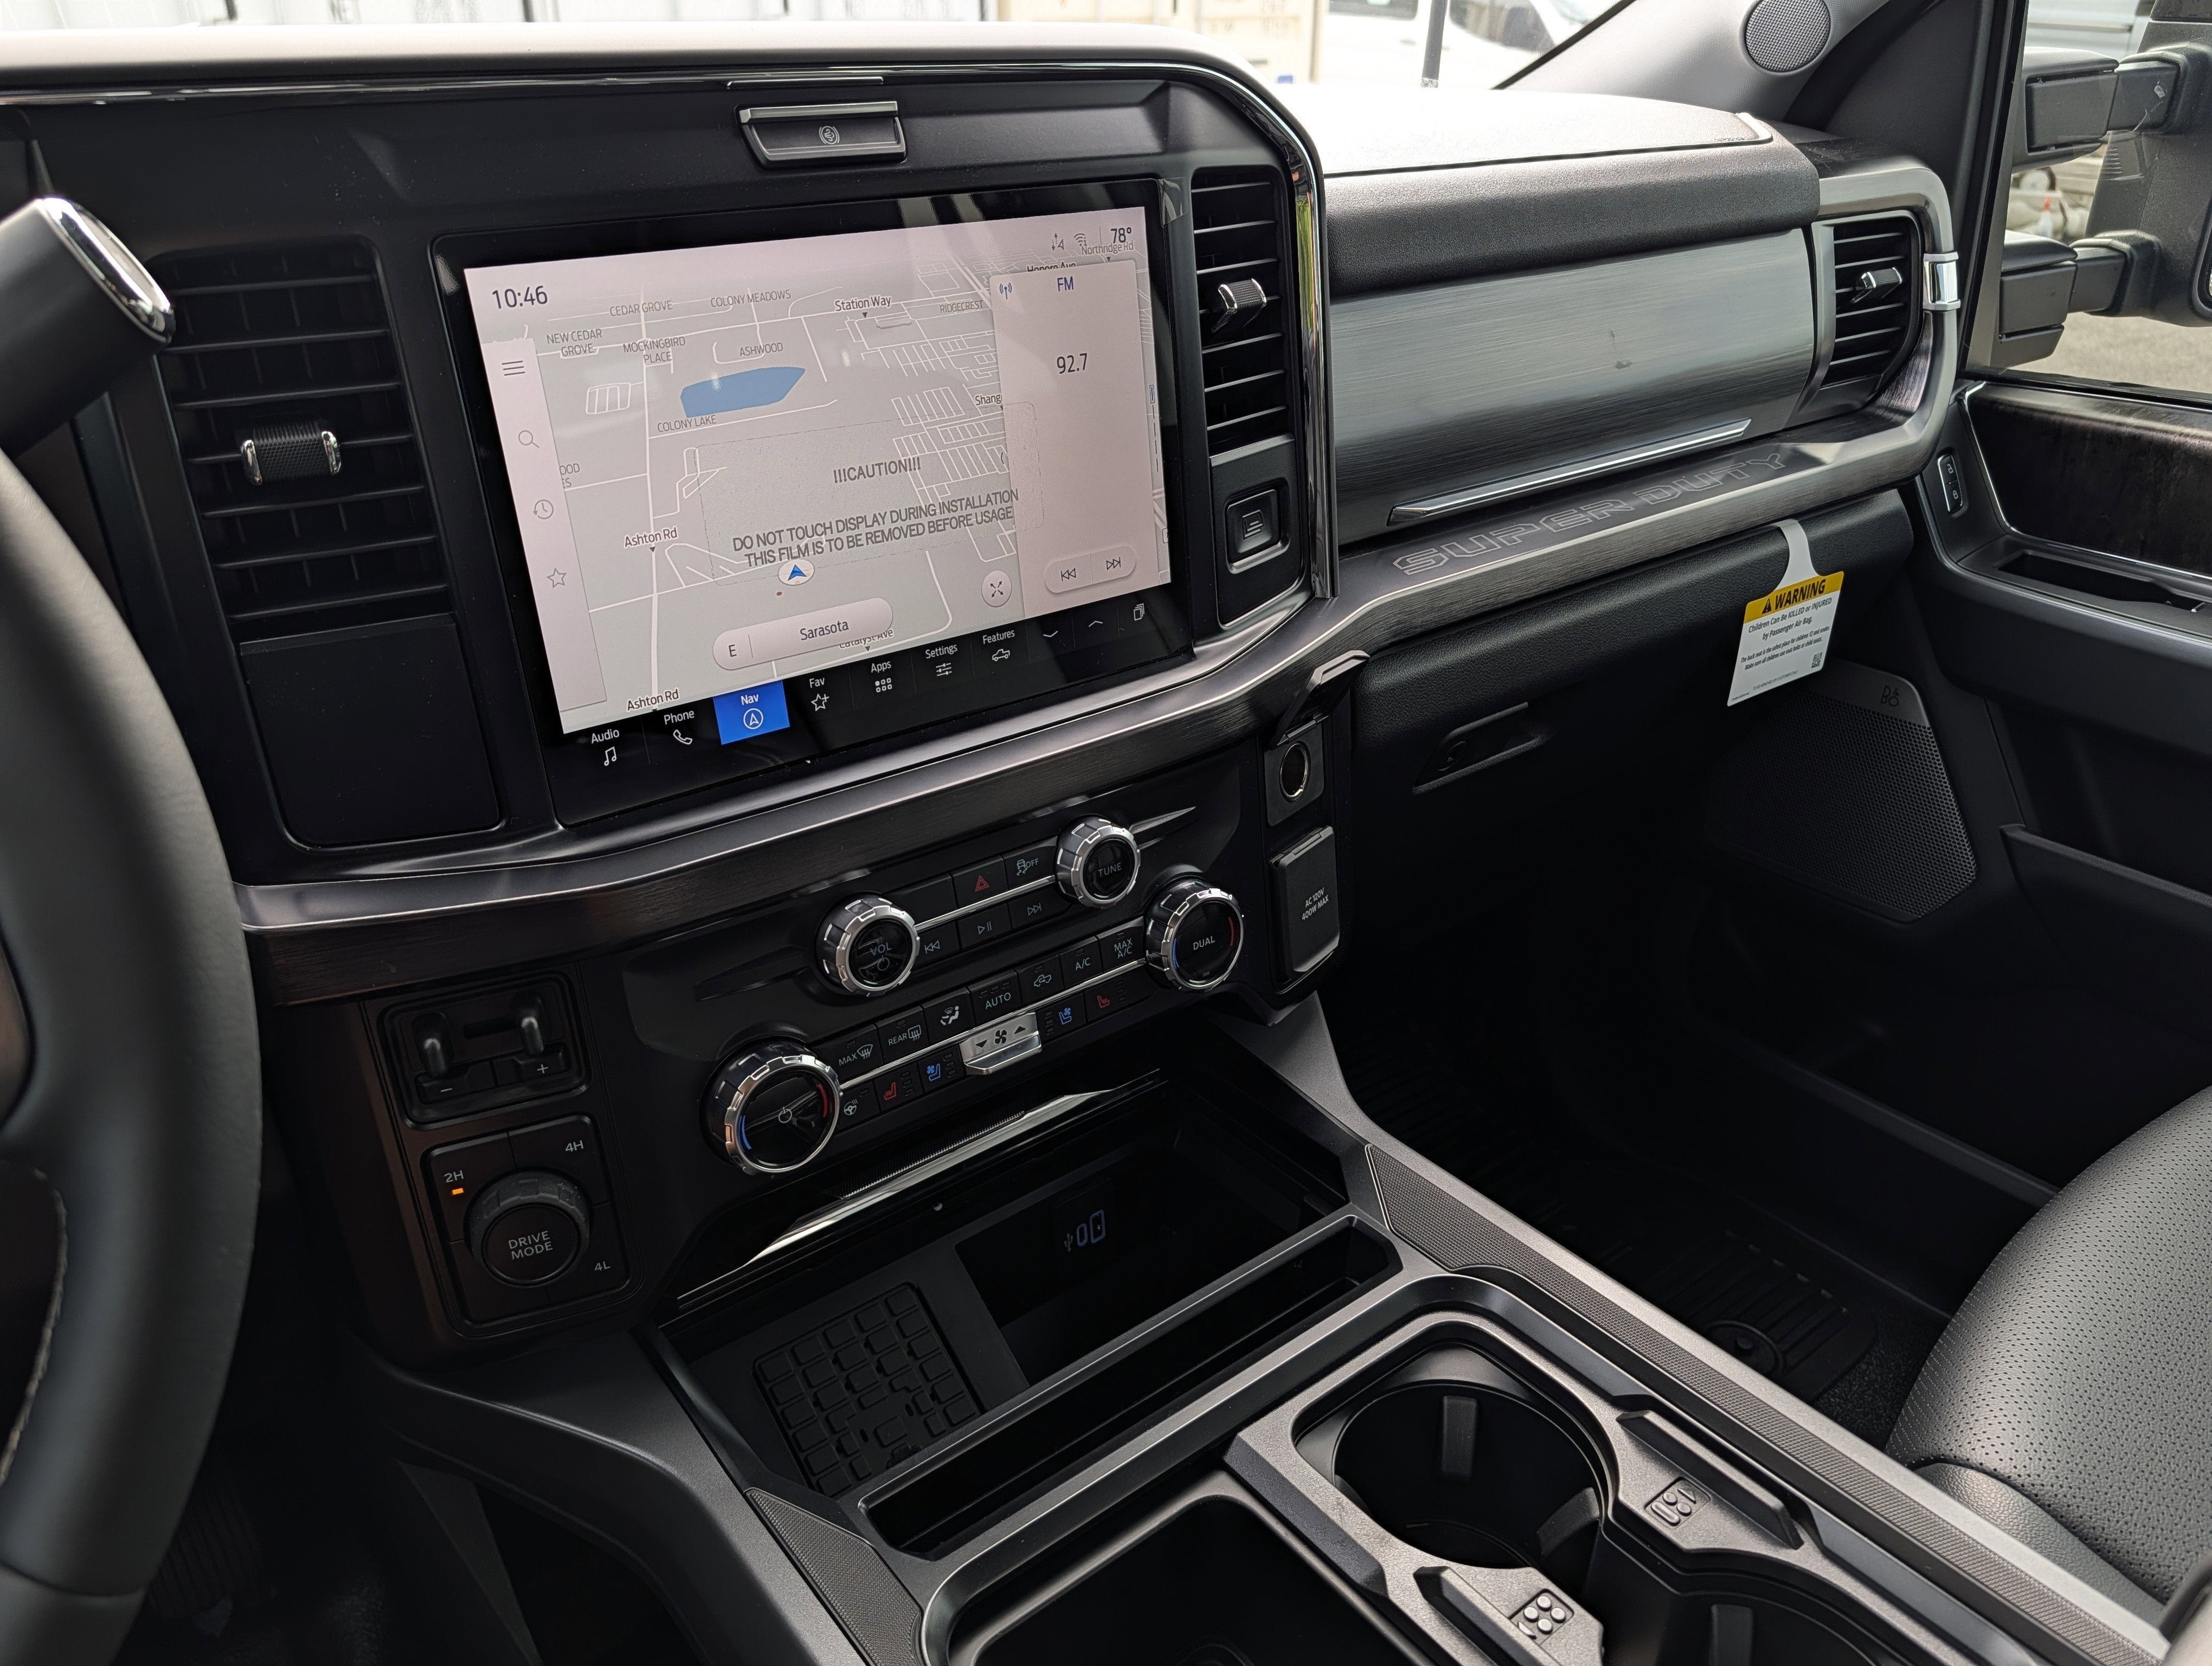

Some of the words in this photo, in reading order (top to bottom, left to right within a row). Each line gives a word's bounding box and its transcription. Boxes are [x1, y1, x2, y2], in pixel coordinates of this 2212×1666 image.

[1081, 242, 1122, 256] Northridge
[1123, 241, 1134, 251] Rd
[1057, 277, 1073, 291] FM
[492, 286, 548, 310] 10:46
[711, 295, 745, 308] COLONY
[748, 290, 791, 304] MEADOWS
[835, 298, 868, 311] Station
[870, 295, 891, 309] Way
[610, 304, 640, 317] CEDAR
[641, 300, 673, 313] GROVE
[940, 299, 983, 314] RIDGECREST
[546, 332, 569, 345] NEW
[571, 329, 602, 342] CEDAR
[623, 336, 685, 353] MOCKINGBIRD
[561, 343, 594, 356] GROVE
[644, 351, 672, 364] PLACE
[740, 342, 783, 357] ASHWOOD
[1057, 353, 1088, 374] 92.7
[657, 419, 691, 433] COLONY
[693, 415, 717, 427] LAKE
[733, 535, 753, 551] DO
[756, 529, 784, 548] NOT
[786, 521, 833, 541] TOUCH
[835, 511, 887, 534] DISPLAY
[890, 503, 936, 524] DURING
[939, 489, 1018, 514] INSTALLATION
[1392, 498, 1635, 575] SUPER
[1632, 453, 1786, 505] DUTY
[625, 531, 661, 547] Ashton
[663, 527, 677, 540] Rd
[744, 549, 776, 567] THIS
[779, 543, 809, 561] FILM
[813, 541, 824, 555] IS
[825, 537, 844, 552] TO
[846, 533, 864, 549] BE
[865, 522, 925, 546] REMOVED
[928, 514, 973, 534] BEFORE
[976, 506, 1013, 524] USAGE
[1774, 579, 1826, 610] WARNING
[1748, 619, 1770, 633] Children
[1771, 617, 1780, 626] Can
[1780, 614, 1787, 623] Be
[1788, 607, 1804, 618] KILLED
[1811, 597, 1831, 612] INJURED
[800, 620, 849, 640] Sarasota
[982, 629, 1015, 644] Features
[1762, 632, 1769, 640] by
[1770, 624, 1793, 638] Passenger
[729, 645, 737, 657] E
[925, 643, 957, 659] Settings
[871, 660, 891, 674] Apps
[809, 677, 825, 689] Fav
[627, 695, 664, 712] Ashton
[665, 689, 679, 701] Rd
[741, 693, 759, 706] Nav
[664, 710, 695, 726] Phone
[591, 728, 619, 744] Audio
[1026, 858, 1039, 868] OFF
[1098, 862, 1122, 877] TUNE
[1306, 897, 1312, 908] AC
[1313, 887, 1324, 901] 120V
[1302, 904, 1316, 920] 400W
[1318, 895, 1328, 908] MAX
[1114, 938, 1133, 951] MAX
[1193, 935, 1215, 950] DUAL
[1118, 946, 1132, 958] A/C
[1075, 958, 1090, 971] A/C
[985, 992, 1011, 1009] AUTO
[888, 1033, 907, 1046] REAR
[839, 1053, 857, 1066] MAX
[565, 1140, 584, 1154] 4H
[444, 1170, 464, 1183] 2H
[508, 1230, 550, 1250] DRIVE
[511, 1241, 554, 1260] MODE
[594, 1261, 610, 1272] 4L
